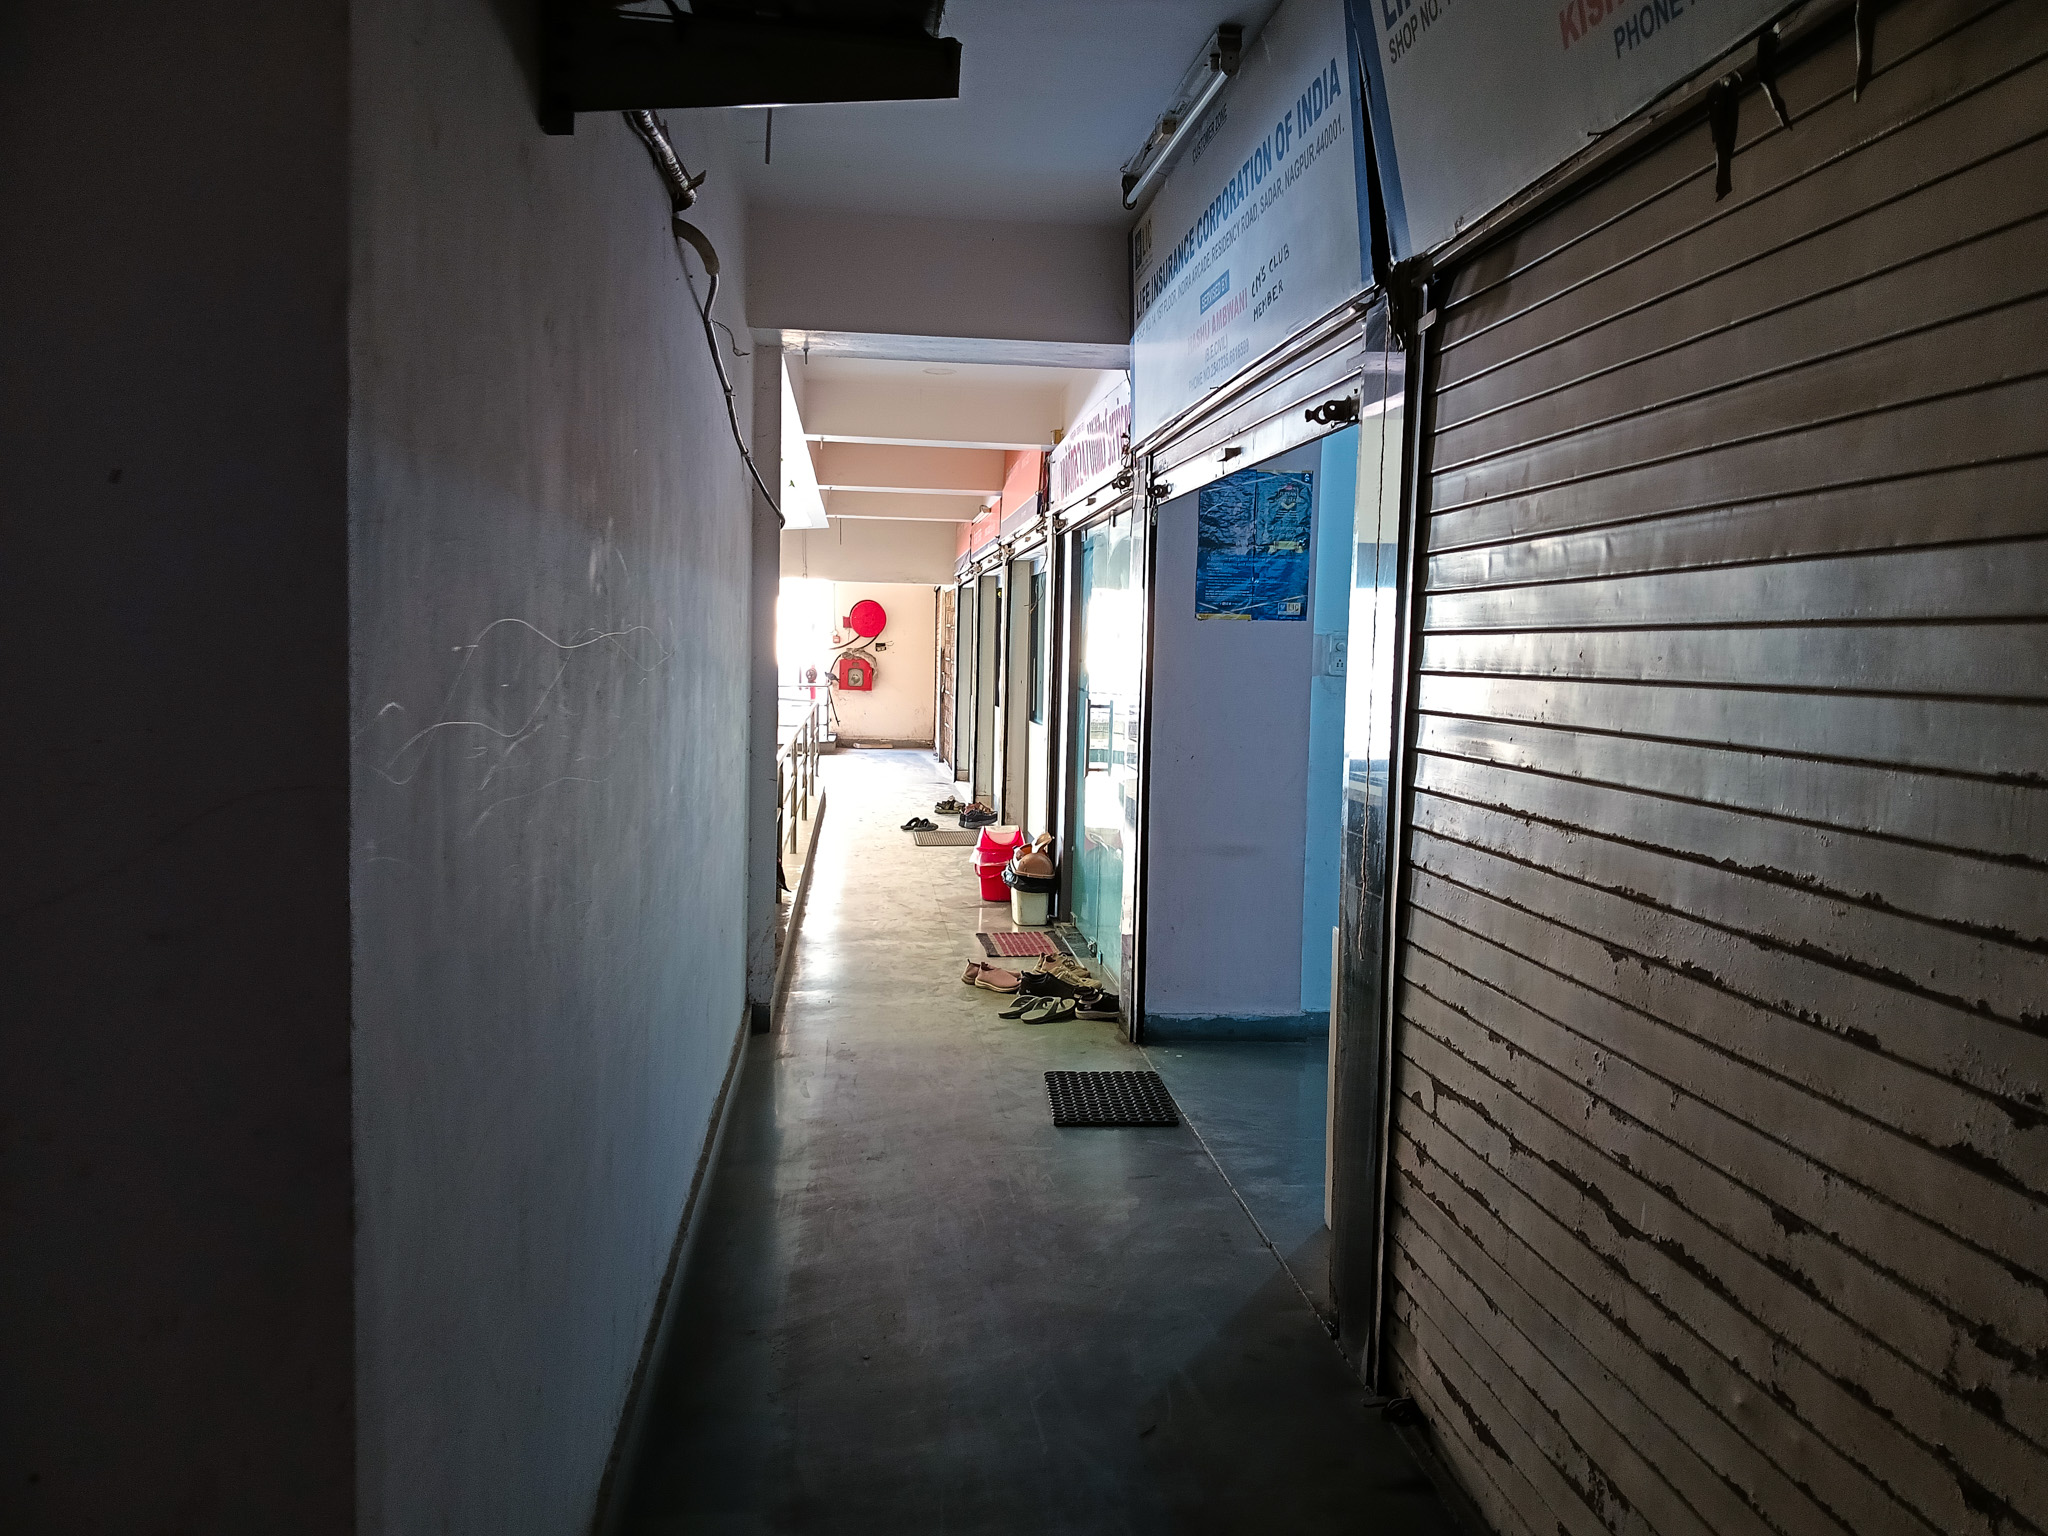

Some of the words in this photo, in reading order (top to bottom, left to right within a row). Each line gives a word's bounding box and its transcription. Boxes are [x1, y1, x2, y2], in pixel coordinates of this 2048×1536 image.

[1388, 14, 1418, 64] SHOP
[1136, 281, 1150, 320] LIFE
[1152, 226, 1195, 303] INSURANCE
[1197, 134, 1273, 250] CORPORATION
[1275, 109, 1293, 162] OF
[1296, 57, 1342, 139] INDIA
[1268, 243, 1290, 273] CLUB
[1253, 279, 1284, 322] MEMBER
